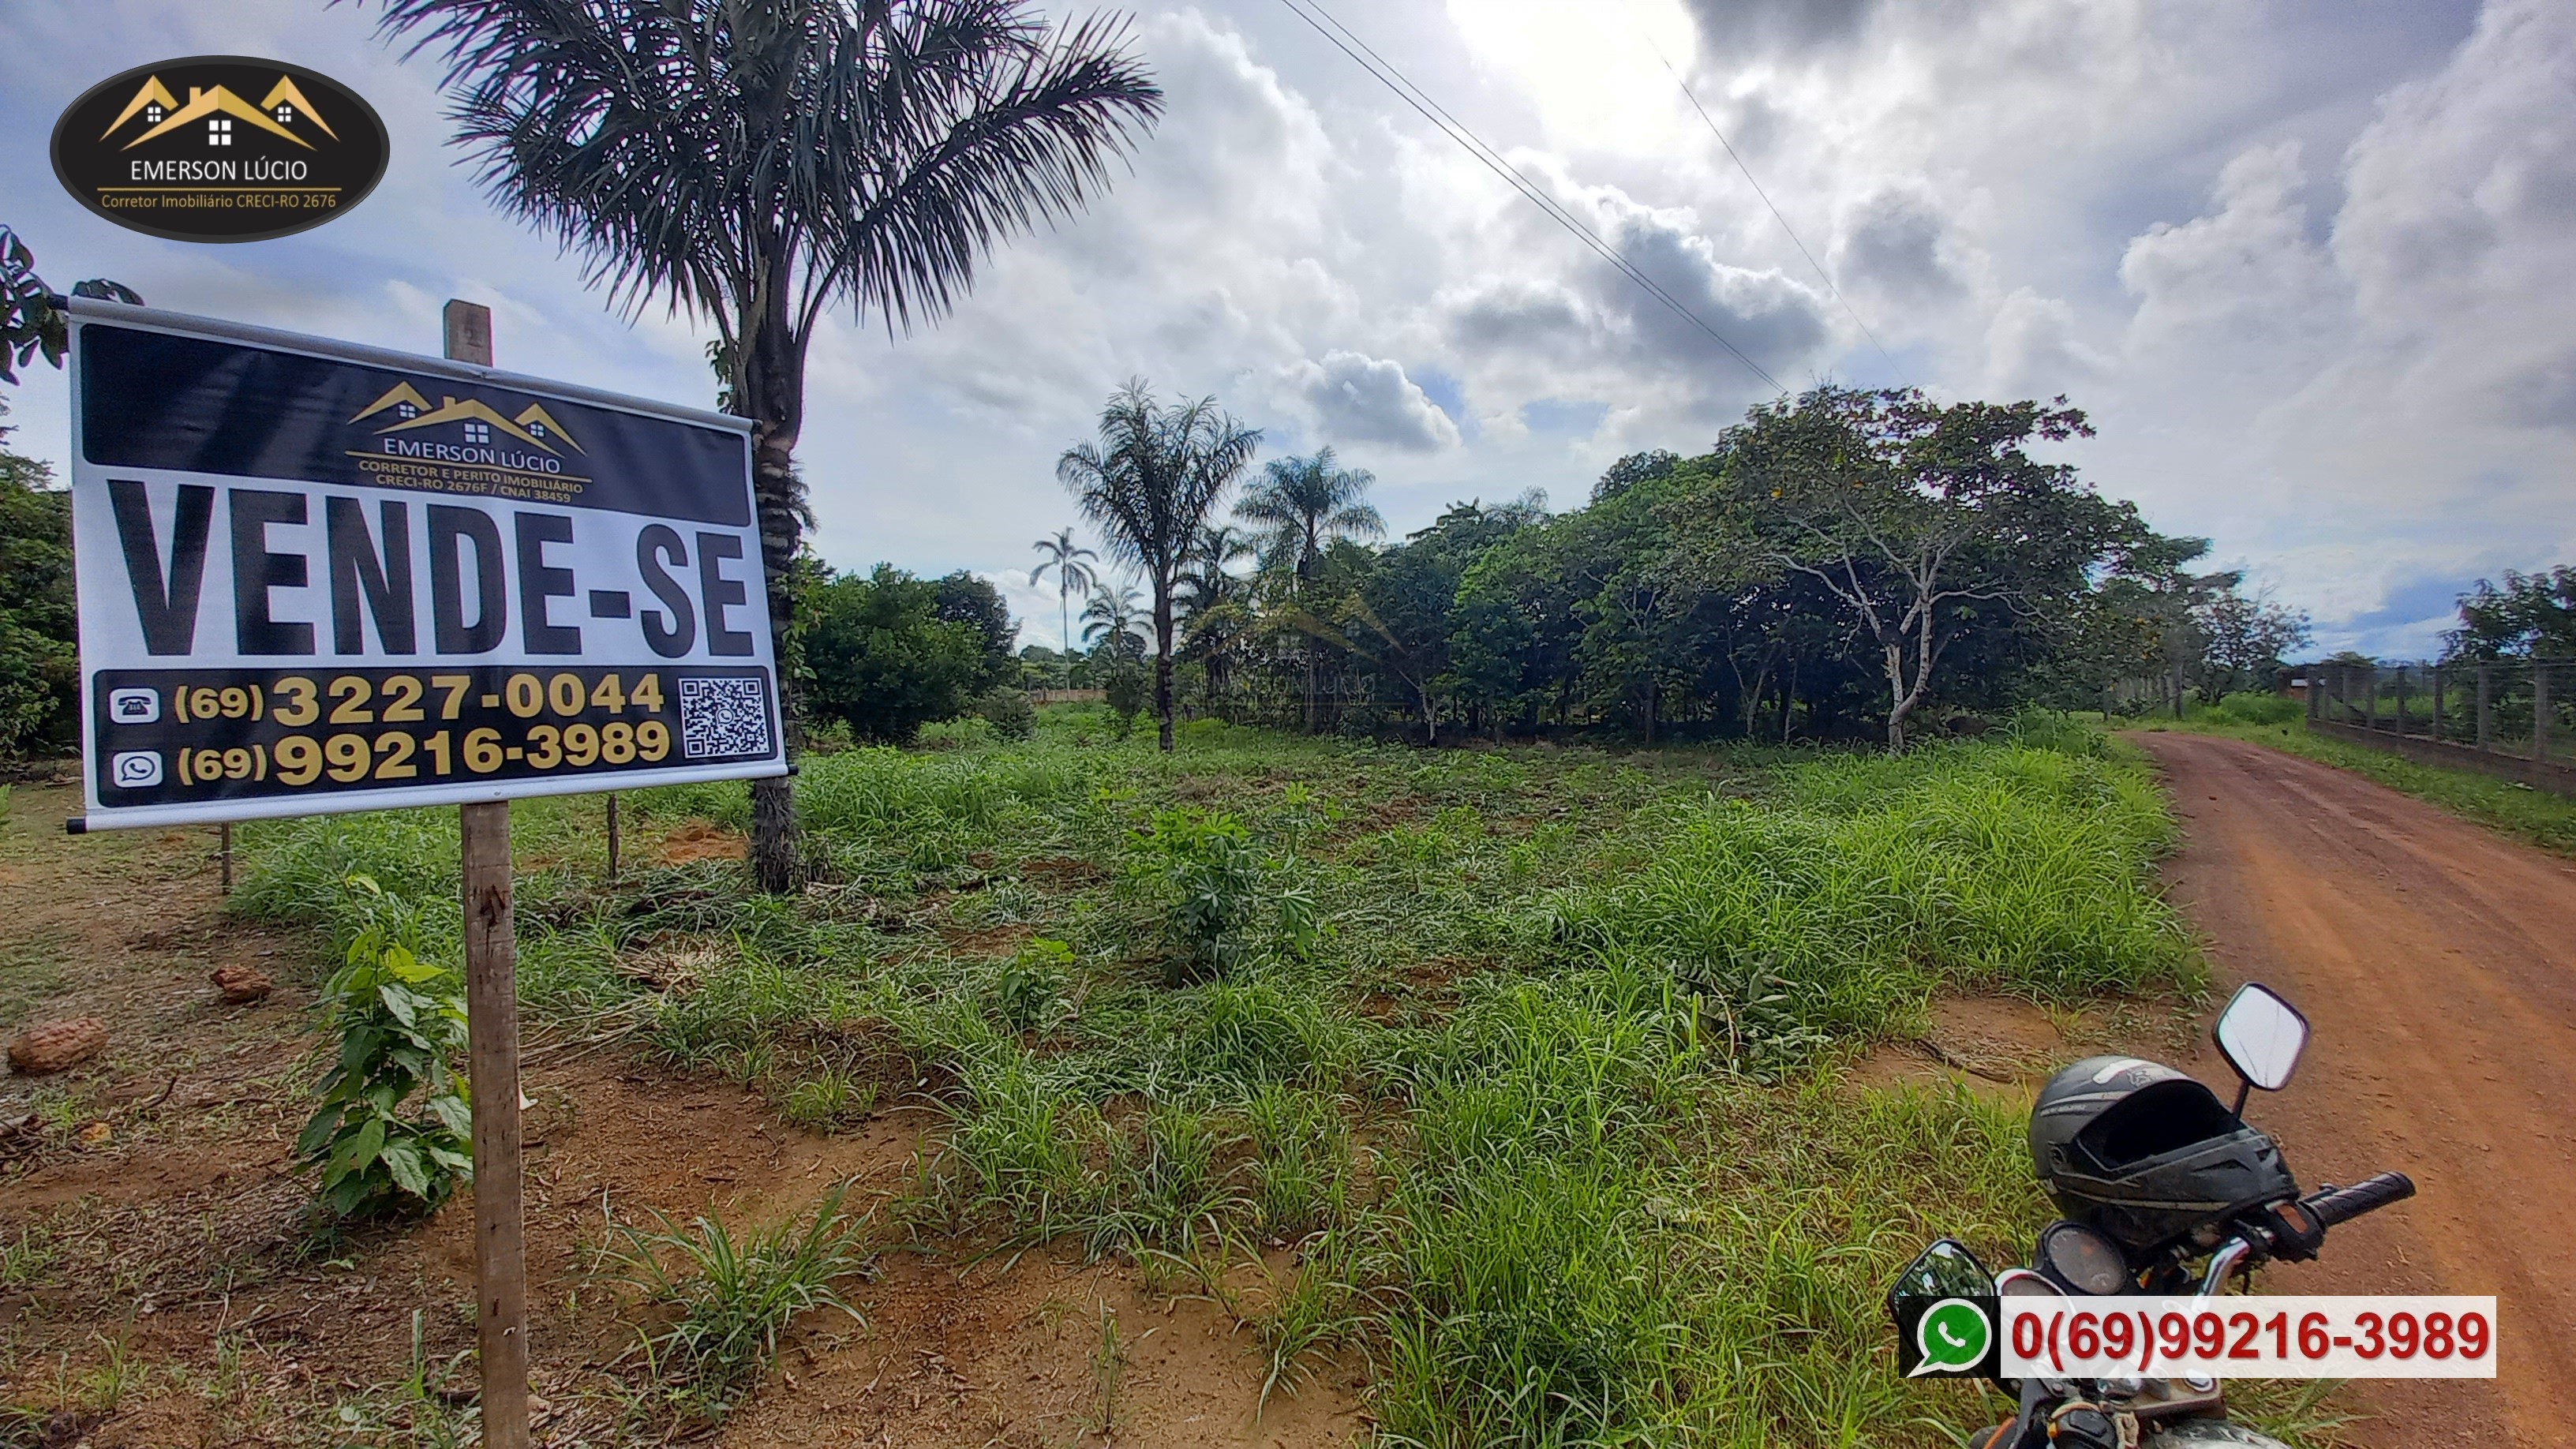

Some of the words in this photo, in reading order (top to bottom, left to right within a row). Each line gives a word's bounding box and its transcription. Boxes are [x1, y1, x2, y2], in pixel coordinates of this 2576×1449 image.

[384, 437, 495, 464] EMERSON
[501, 450, 560, 474] LÚCIO
[358, 460, 439, 477] CORRETOR
[442, 468, 451, 479] E
[453, 470, 501, 483] PERITO
[504, 475, 584, 494] IMOBILIÁRIO
[376, 474, 444, 490] CRECI-RO
[447, 481, 488, 492] 2676F
[500, 486, 531, 499] CNAI
[534, 490, 571, 504] 38459
[107, 478, 754, 658] VENDE-SE
